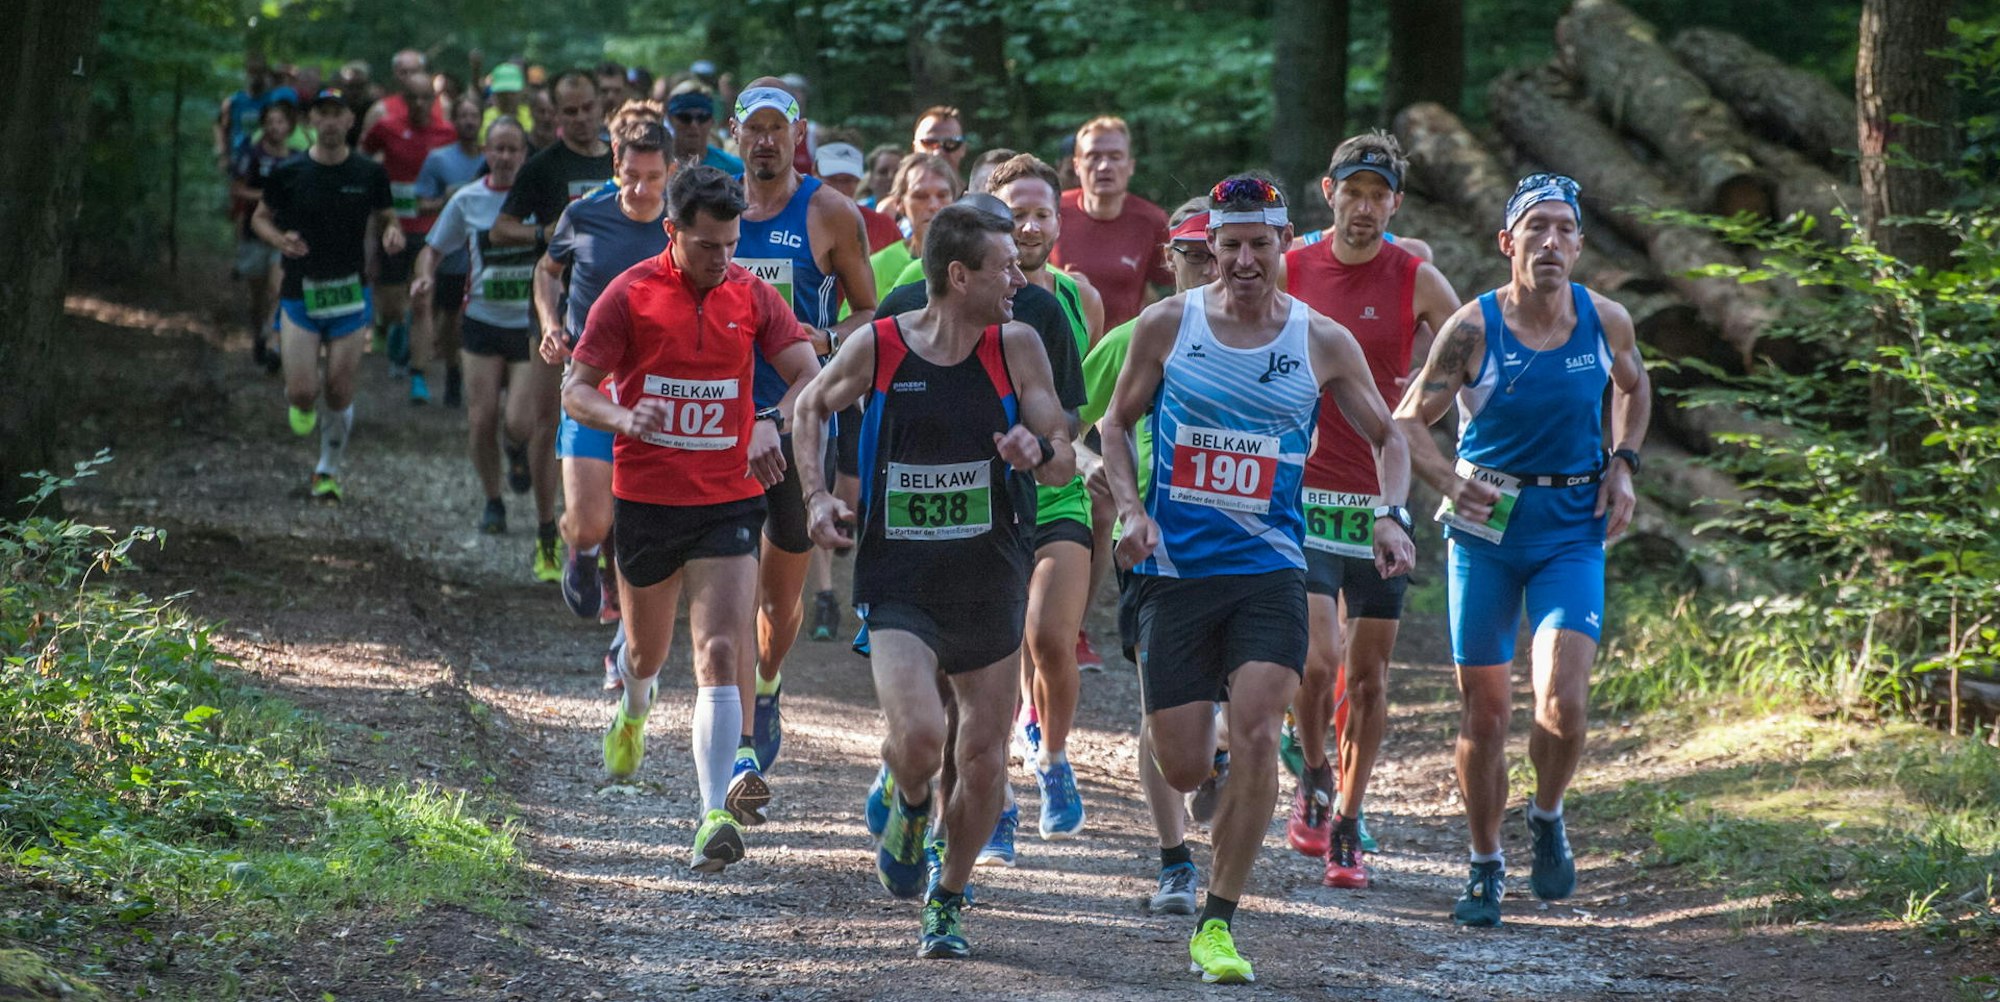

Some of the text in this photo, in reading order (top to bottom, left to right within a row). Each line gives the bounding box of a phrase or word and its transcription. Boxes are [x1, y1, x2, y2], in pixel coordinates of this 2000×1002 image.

[1565, 354, 1595, 369] SALTO
[660, 383, 725, 399] BELKAW
[662, 400, 725, 436] 102
[1192, 433, 1262, 455] BELKAW
[900, 470, 977, 489] BELKAW
[1190, 452, 1261, 495] 190
[1177, 492, 1203, 504] Partner
[1308, 492, 1371, 507] BELKAW
[908, 492, 968, 526] 638
[895, 528, 922, 536] Partner
[1306, 506, 1370, 543] 613
